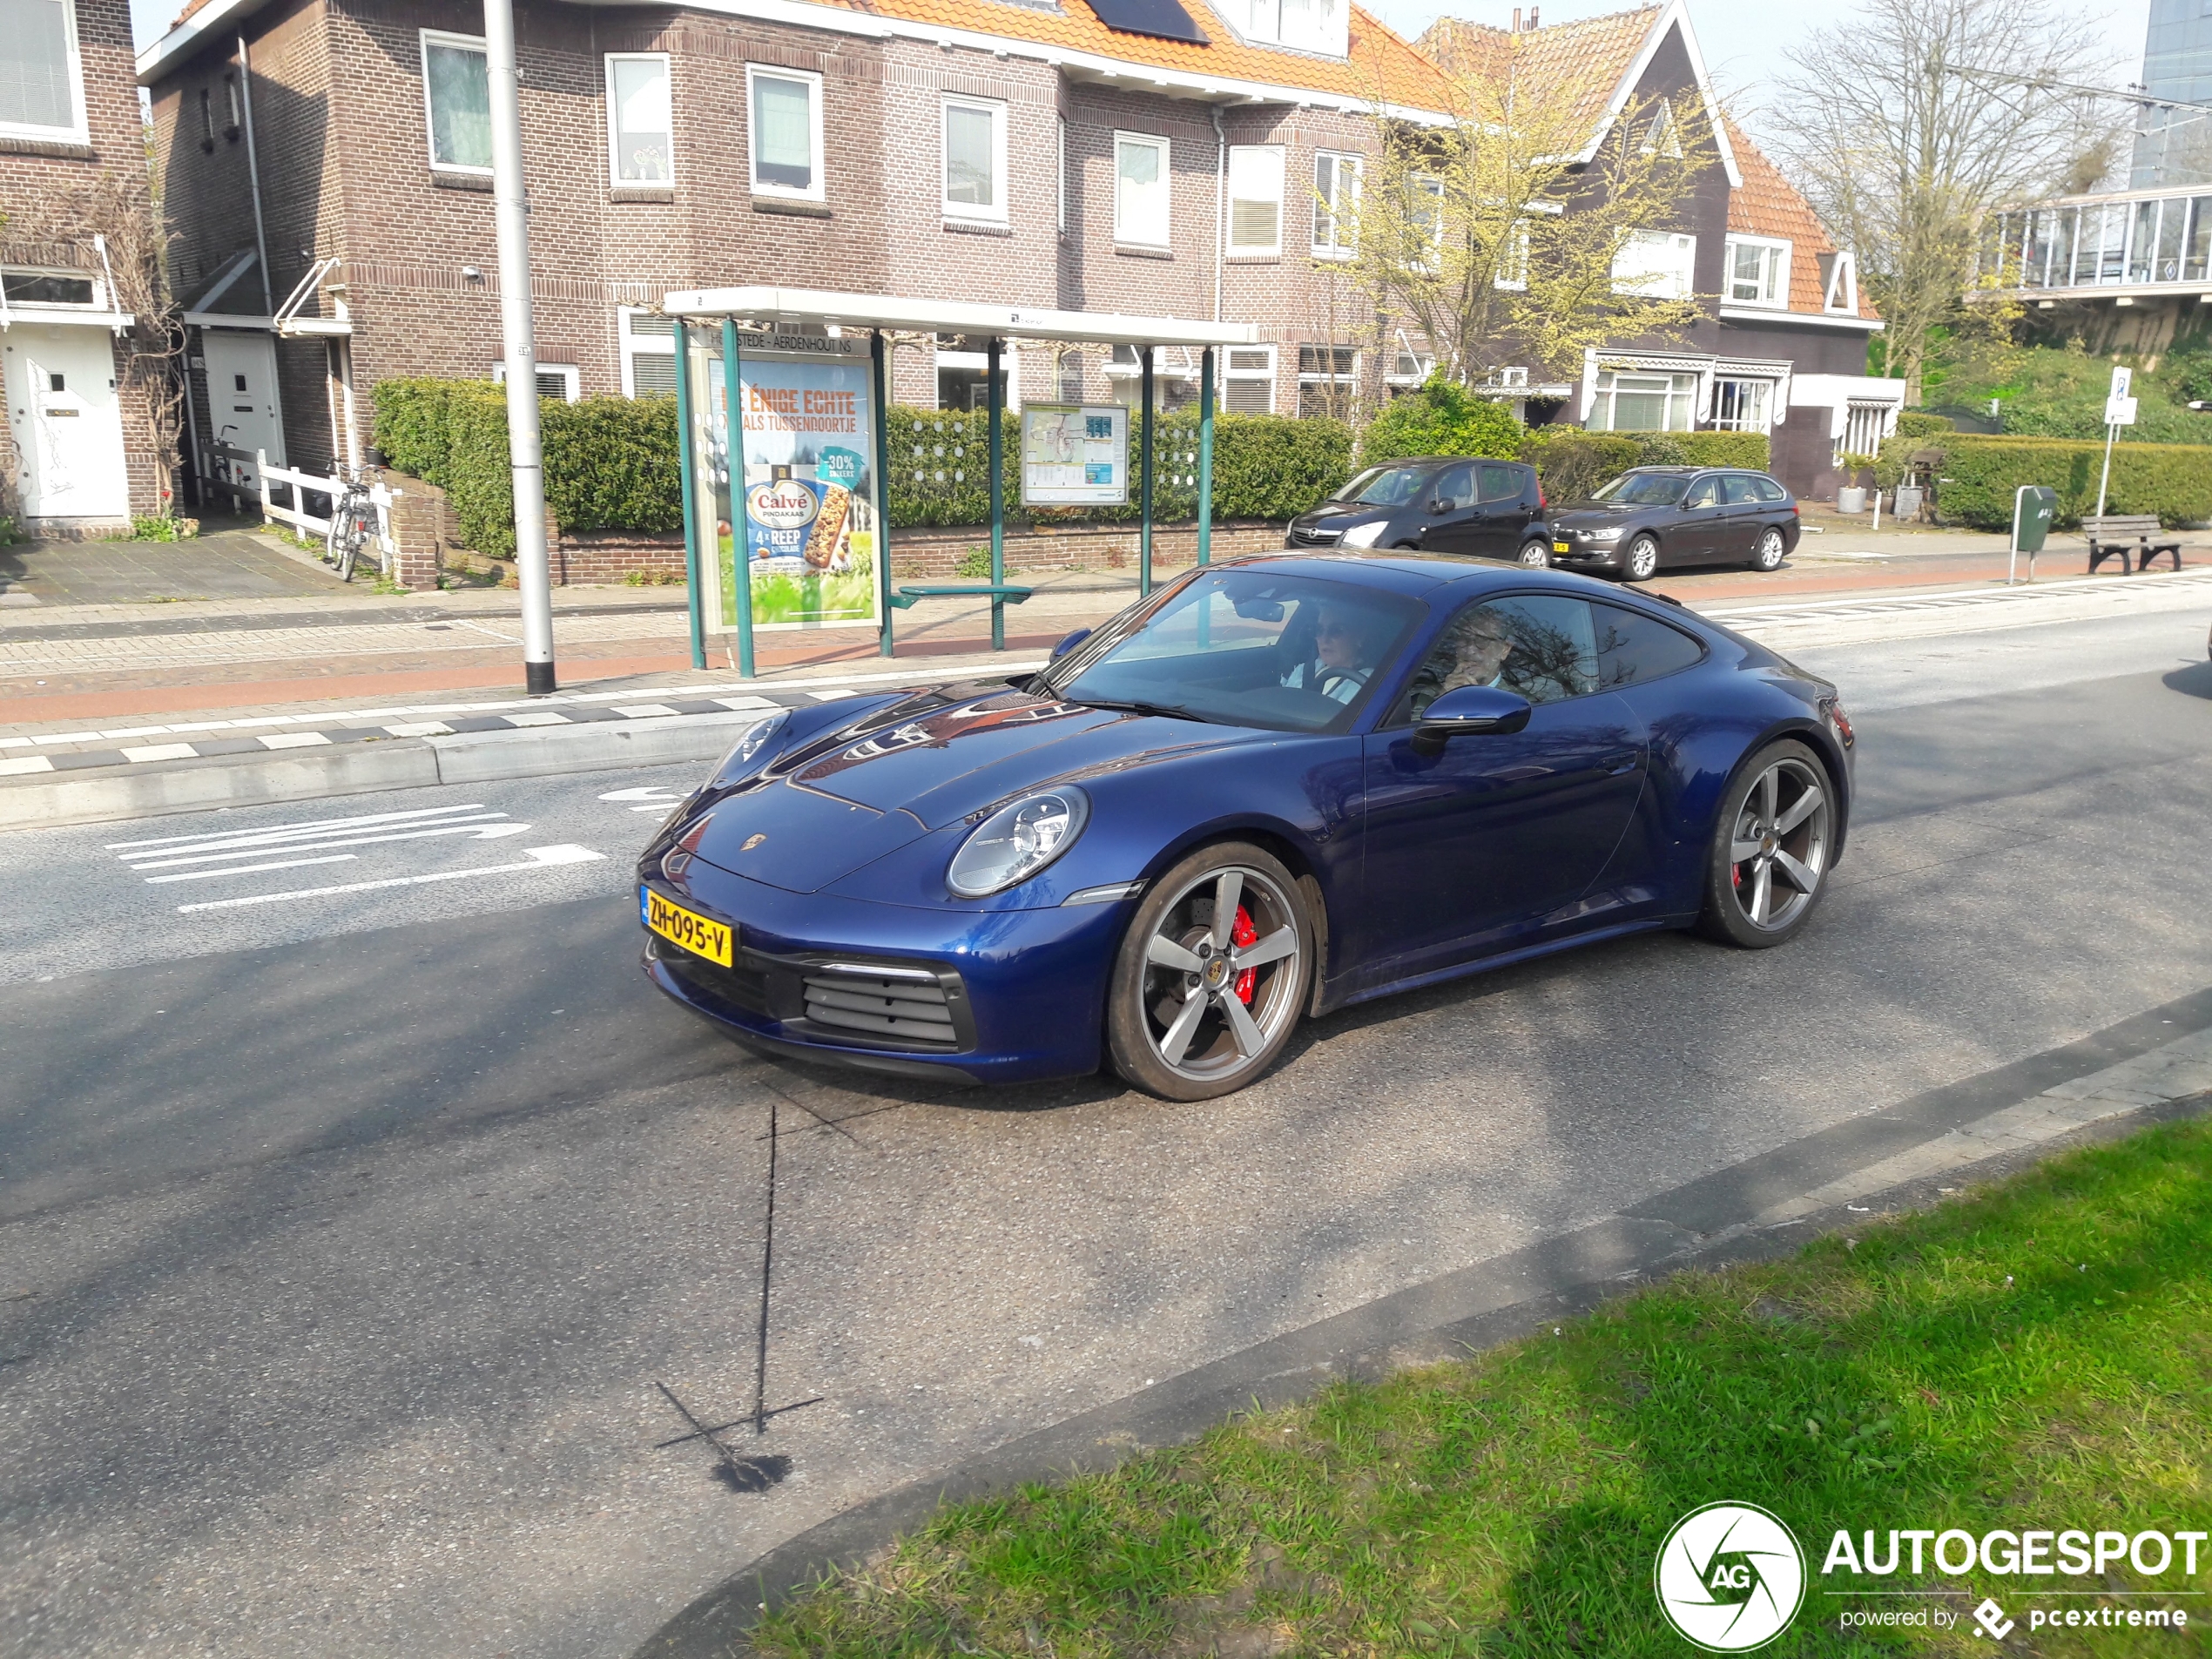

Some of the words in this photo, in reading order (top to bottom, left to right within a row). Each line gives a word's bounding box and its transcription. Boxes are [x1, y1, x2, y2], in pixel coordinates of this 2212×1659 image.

[711, 332, 765, 347] HESTEDE
[773, 336, 837, 351] AERDENHOUT
[839, 340, 852, 352] NS
[750, 383, 799, 414] ÉNIGE
[804, 389, 855, 415] ECHTE
[744, 415, 765, 430] ALS
[767, 415, 856, 433] TUSSENDOORTJE
[823, 455, 854, 470] -30%
[758, 493, 807, 509] Calvé
[771, 529, 801, 545] REEP
[650, 895, 725, 958] ZH-095-V
